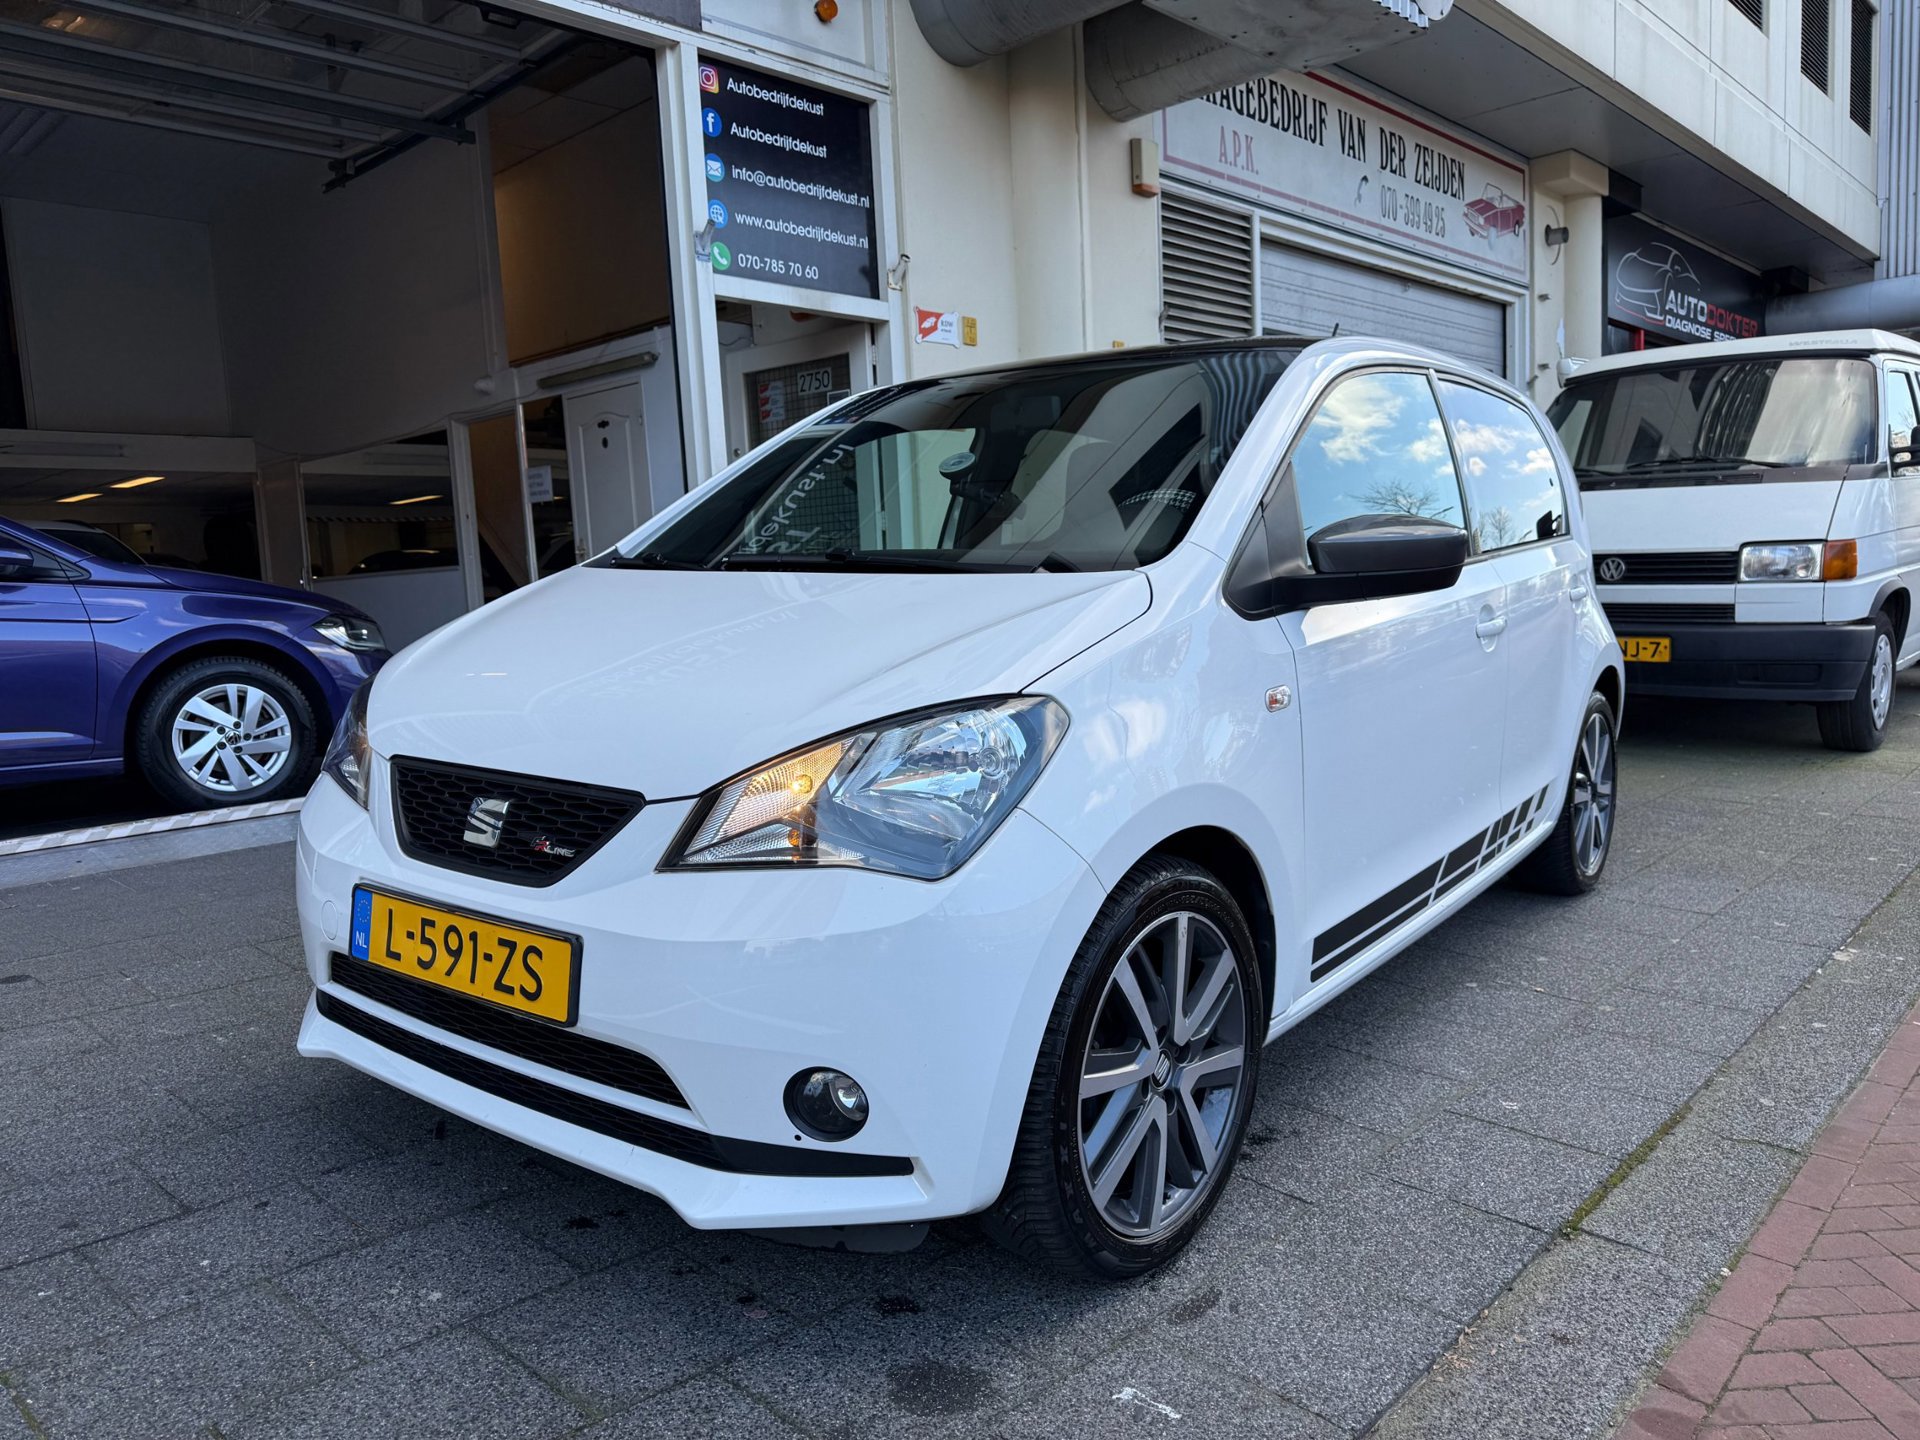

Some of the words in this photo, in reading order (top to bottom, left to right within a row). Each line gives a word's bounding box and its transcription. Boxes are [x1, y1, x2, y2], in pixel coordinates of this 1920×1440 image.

[727, 77, 824, 116] Autobedrijfdekust
[730, 122, 827, 158] Autobedrijfdekust
[1218, 125, 1259, 175] A.P.K.
[1337, 108, 1366, 163] VAN
[1379, 126, 1407, 179] DER
[1414, 141, 1465, 201] ZEIJDEN
[731, 165, 870, 208] info@autobedrijfdekust.nl
[735, 211, 868, 249] www.autobedrijfdekust.nl
[1422, 200, 1433, 234] 49
[1434, 205, 1446, 238] 25
[738, 253, 785, 275] 070-785
[789, 261, 802, 277] 70
[805, 265, 819, 280] 60
[1665, 314, 1712, 340] DIAGNOSE
[799, 369, 831, 393] 2750
[355, 929, 368, 949] NL
[386, 908, 543, 1002] L-591-ZS
